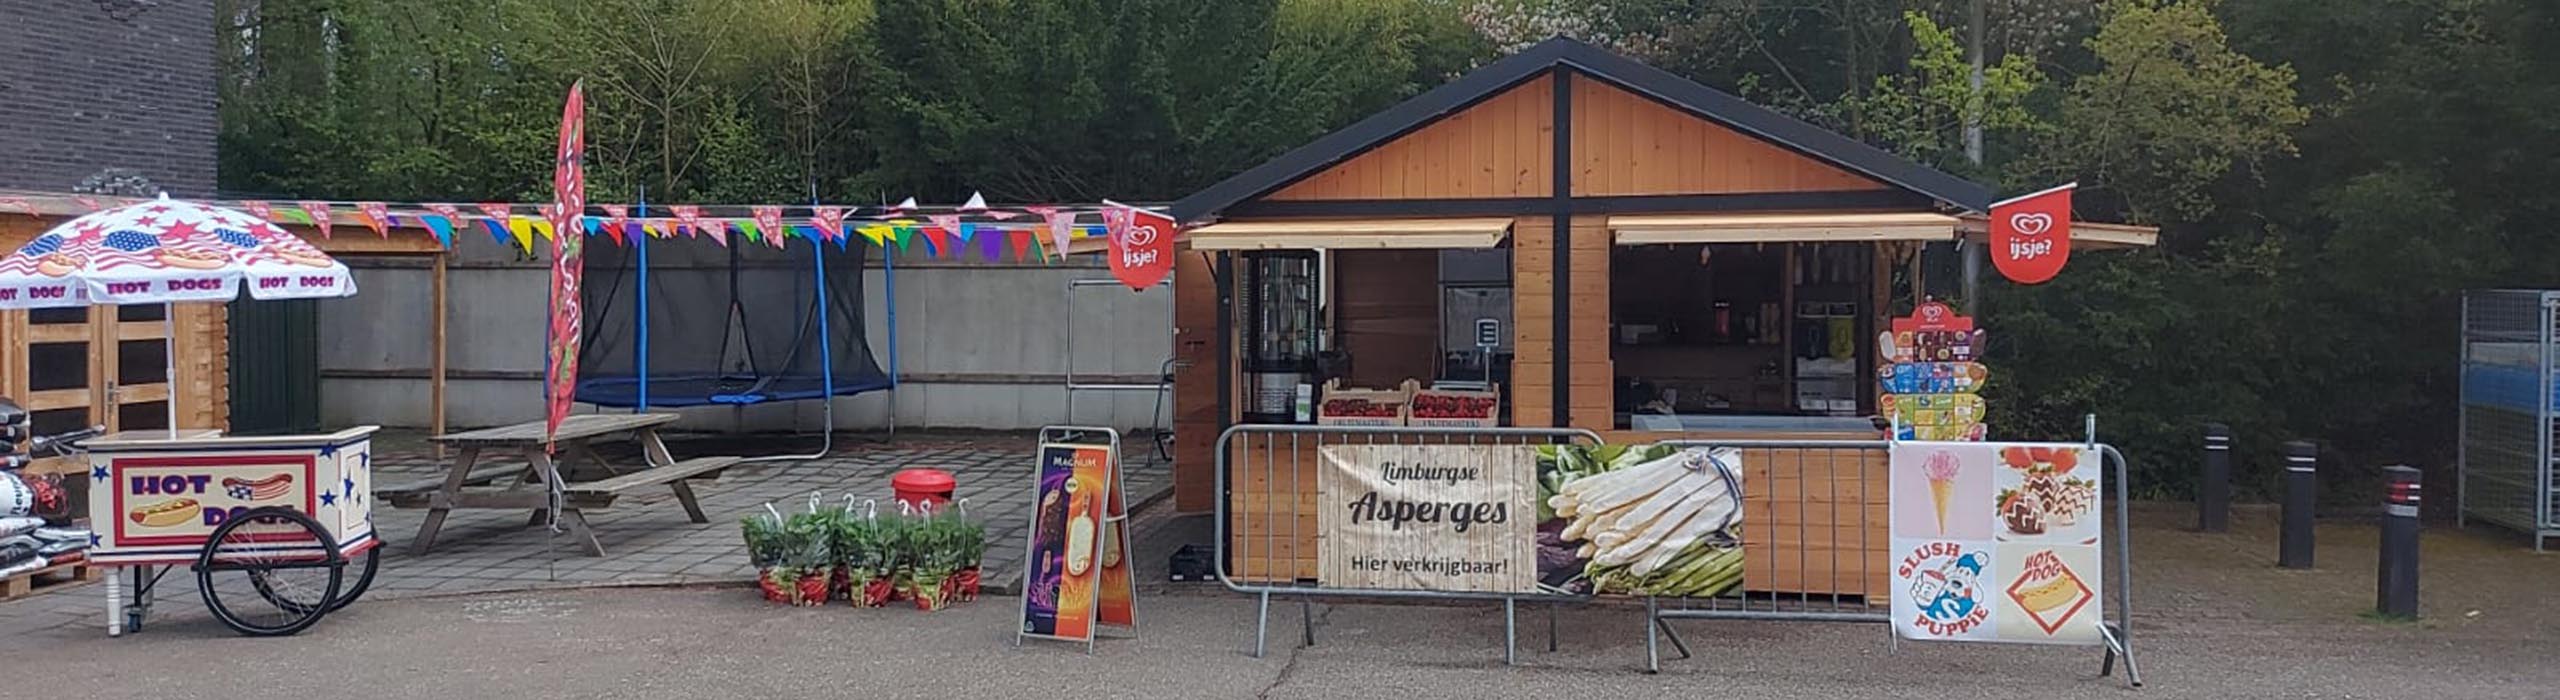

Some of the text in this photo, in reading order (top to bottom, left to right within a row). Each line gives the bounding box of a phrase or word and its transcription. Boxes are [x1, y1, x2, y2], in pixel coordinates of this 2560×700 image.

[1123, 248, 1158, 268] ijsje?
[2009, 237, 2053, 260] ijsje?
[107, 278, 222, 295] HOT DOGS
[260, 276, 334, 289] HOT DOGS
[0, 288, 18, 302] OT
[131, 474, 212, 495] HOT
[1380, 461, 1479, 487] Limburgse
[203, 505, 294, 526] DO
[1348, 491, 1508, 533] Asperges
[1351, 555, 1508, 576] Hier verkrijgbaar!
[1898, 542, 1961, 579] SLUSH
[2025, 550, 2052, 570] HOT
[2032, 562, 2060, 581] DOG
